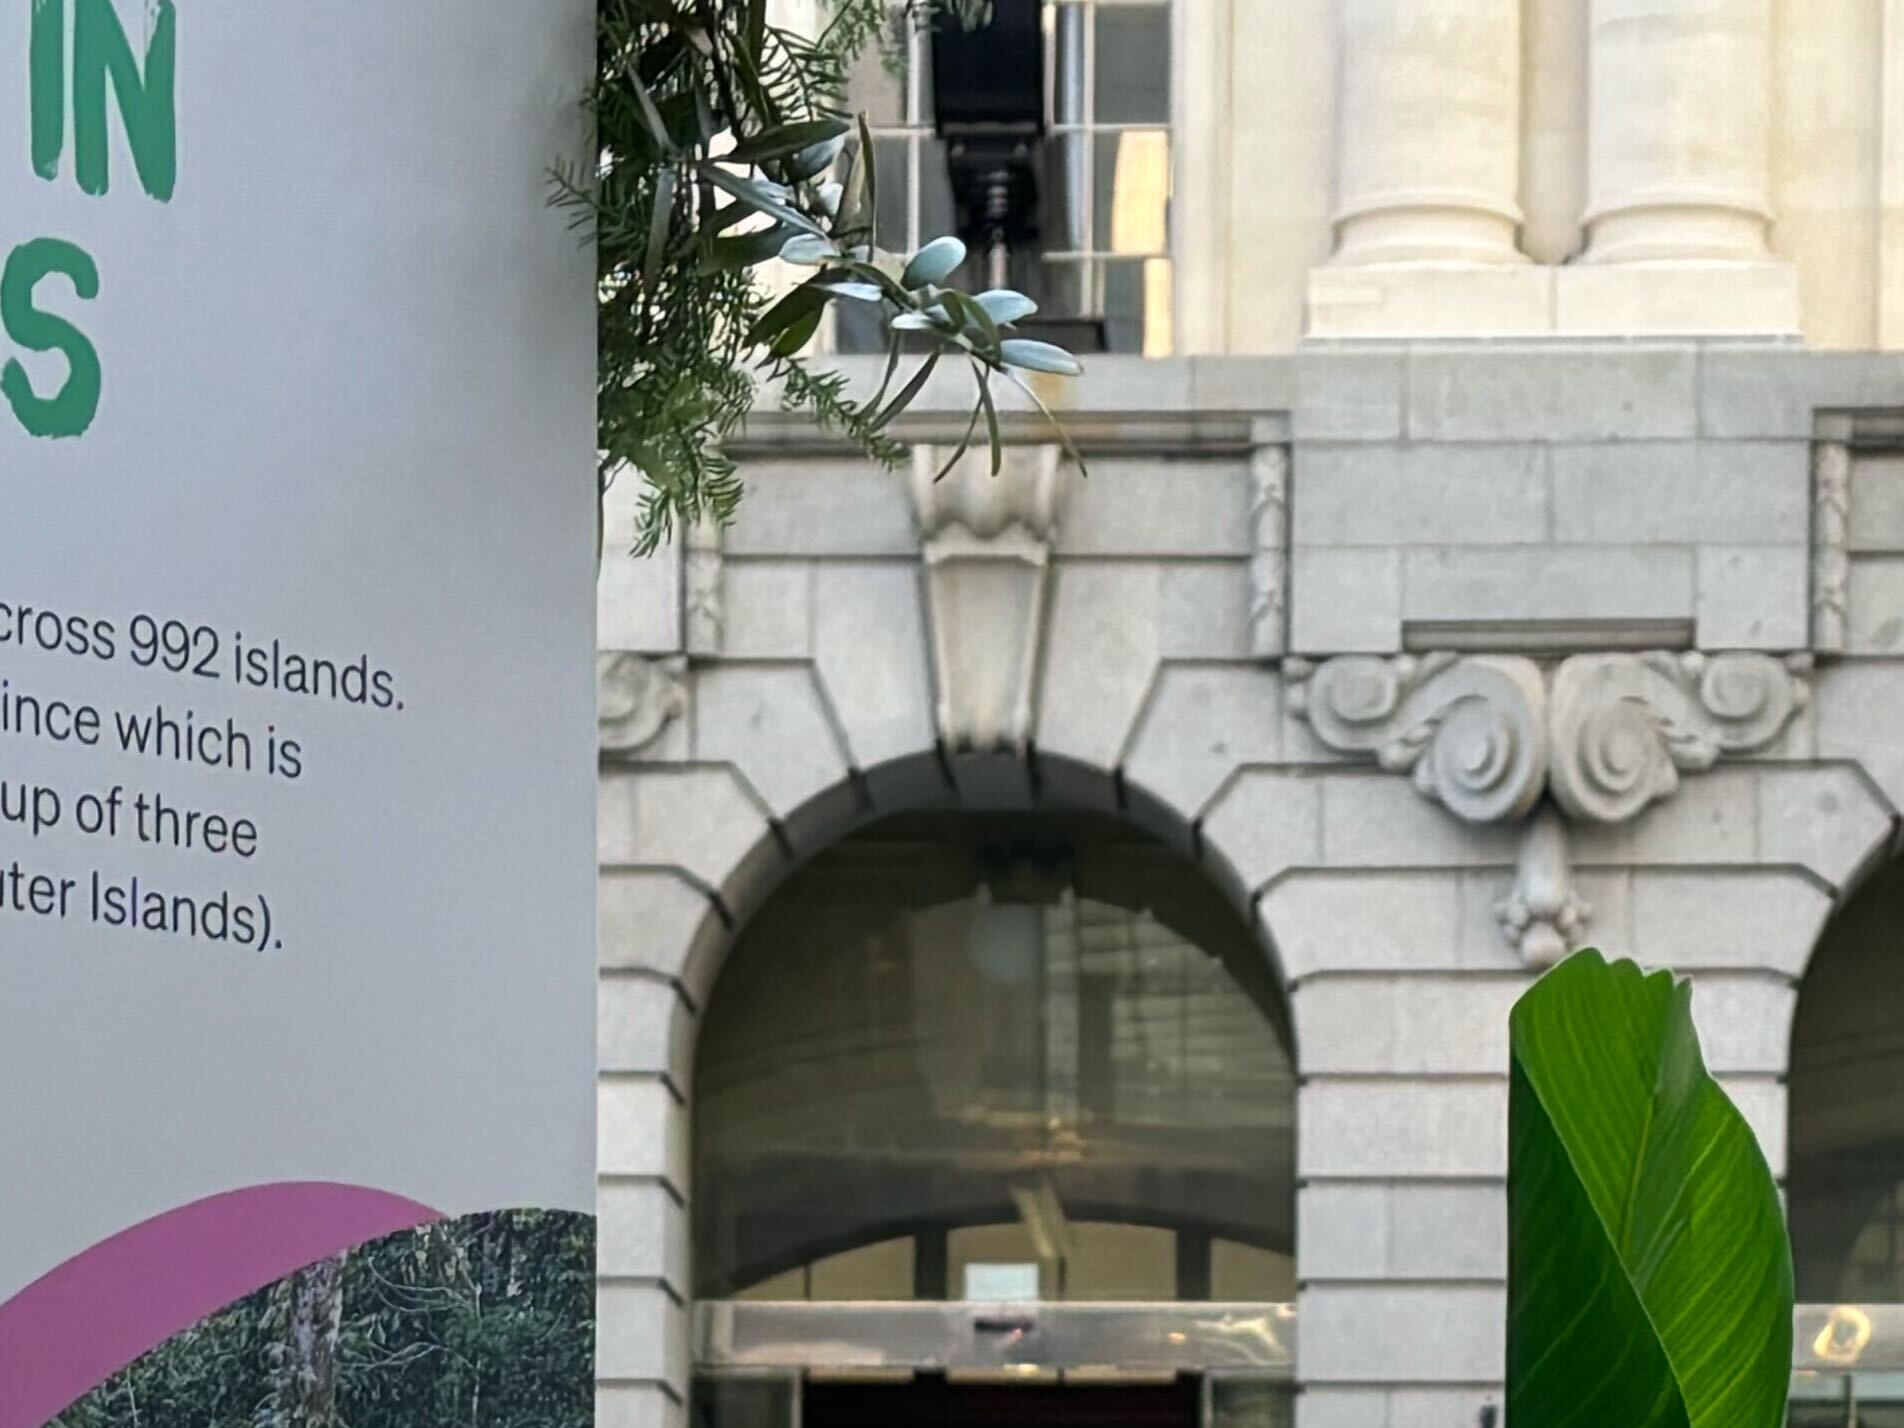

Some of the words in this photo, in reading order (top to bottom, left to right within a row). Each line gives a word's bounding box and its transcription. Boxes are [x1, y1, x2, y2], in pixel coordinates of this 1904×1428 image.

[26, 0, 181, 205] IN
[129, 614, 221, 679] 992
[235, 631, 404, 711] islands.
[114, 705, 251, 771] which
[268, 725, 302, 779] is
[0, 781, 61, 837] up
[75, 785, 123, 837] of
[134, 793, 258, 858] three
[91, 870, 282, 953] Islands).
